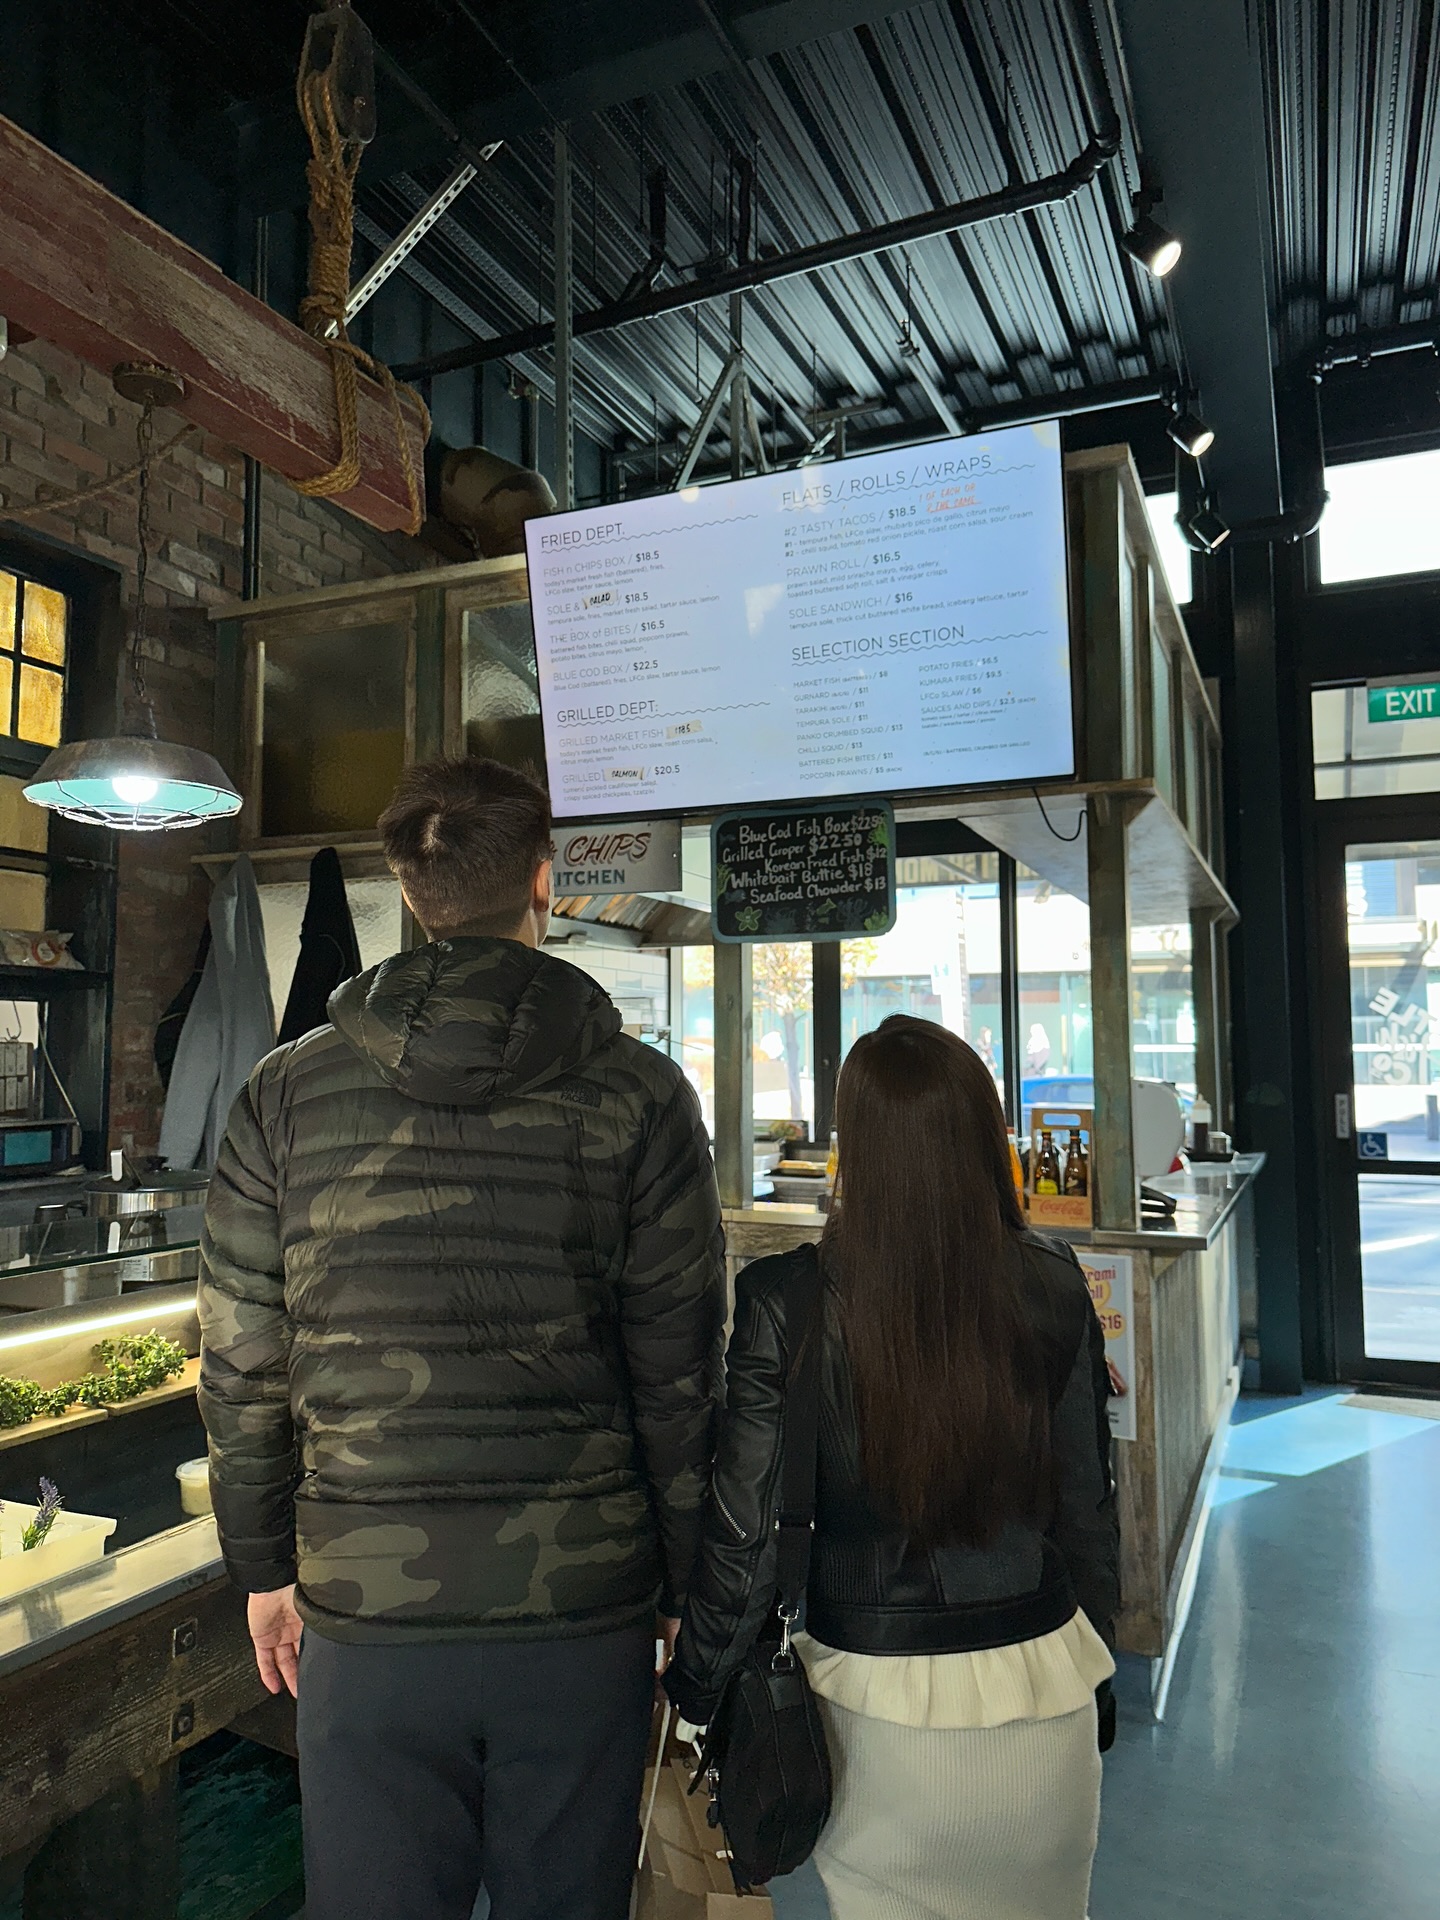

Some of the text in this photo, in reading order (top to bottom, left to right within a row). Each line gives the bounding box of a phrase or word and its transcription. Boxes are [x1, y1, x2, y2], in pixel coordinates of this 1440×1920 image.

[782, 454, 992, 505] FLATS ROLLS WRAPS
[784, 505, 917, 537] #2 TASTY TACOS $18.5
[541, 522, 625, 549] FRIED DEPT.
[543, 566, 564, 578] FISH
[574, 559, 603, 573] CHIPS
[604, 555, 625, 568] BOX
[635, 550, 660, 563] $18.5
[786, 551, 901, 579] PRAWN ROLL $16.5
[547, 602, 571, 616] SOLE
[574, 602, 580, 612] &
[625, 591, 649, 604] $18.5
[788, 591, 913, 620] SOLE SANDWICH $16
[550, 633, 568, 644] THE
[570, 630, 591, 642] BOX
[604, 624, 631, 638] BITES
[641, 619, 665, 632] $16.5
[792, 625, 964, 661] SELECTION SECTION
[553, 659, 659, 682] BLUE COD BOX $22.5
[1386, 688, 1436, 716] EXIT
[558, 735, 599, 748] GRILLED
[599, 730, 640, 743] MARKET
[641, 728, 664, 739] FISH
[562, 772, 601, 784] GRILLED
[654, 764, 681, 776] $20.5
[739, 825, 767, 845] Blue
[768, 822, 791, 840] Cod
[796, 818, 821, 837] Fish
[824, 817, 848, 833] Box
[564, 832, 651, 866] CHIPS
[722, 845, 764, 863] Grilled
[764, 847, 887, 874] Korean Fried Fish $12
[554, 869, 625, 886] ITCHEN
[731, 871, 796, 889] Whitebait
[847, 862, 873, 881] $18
[750, 875, 887, 904] Seafood Chowder $13
[1085, 1264, 1116, 1281] rami
